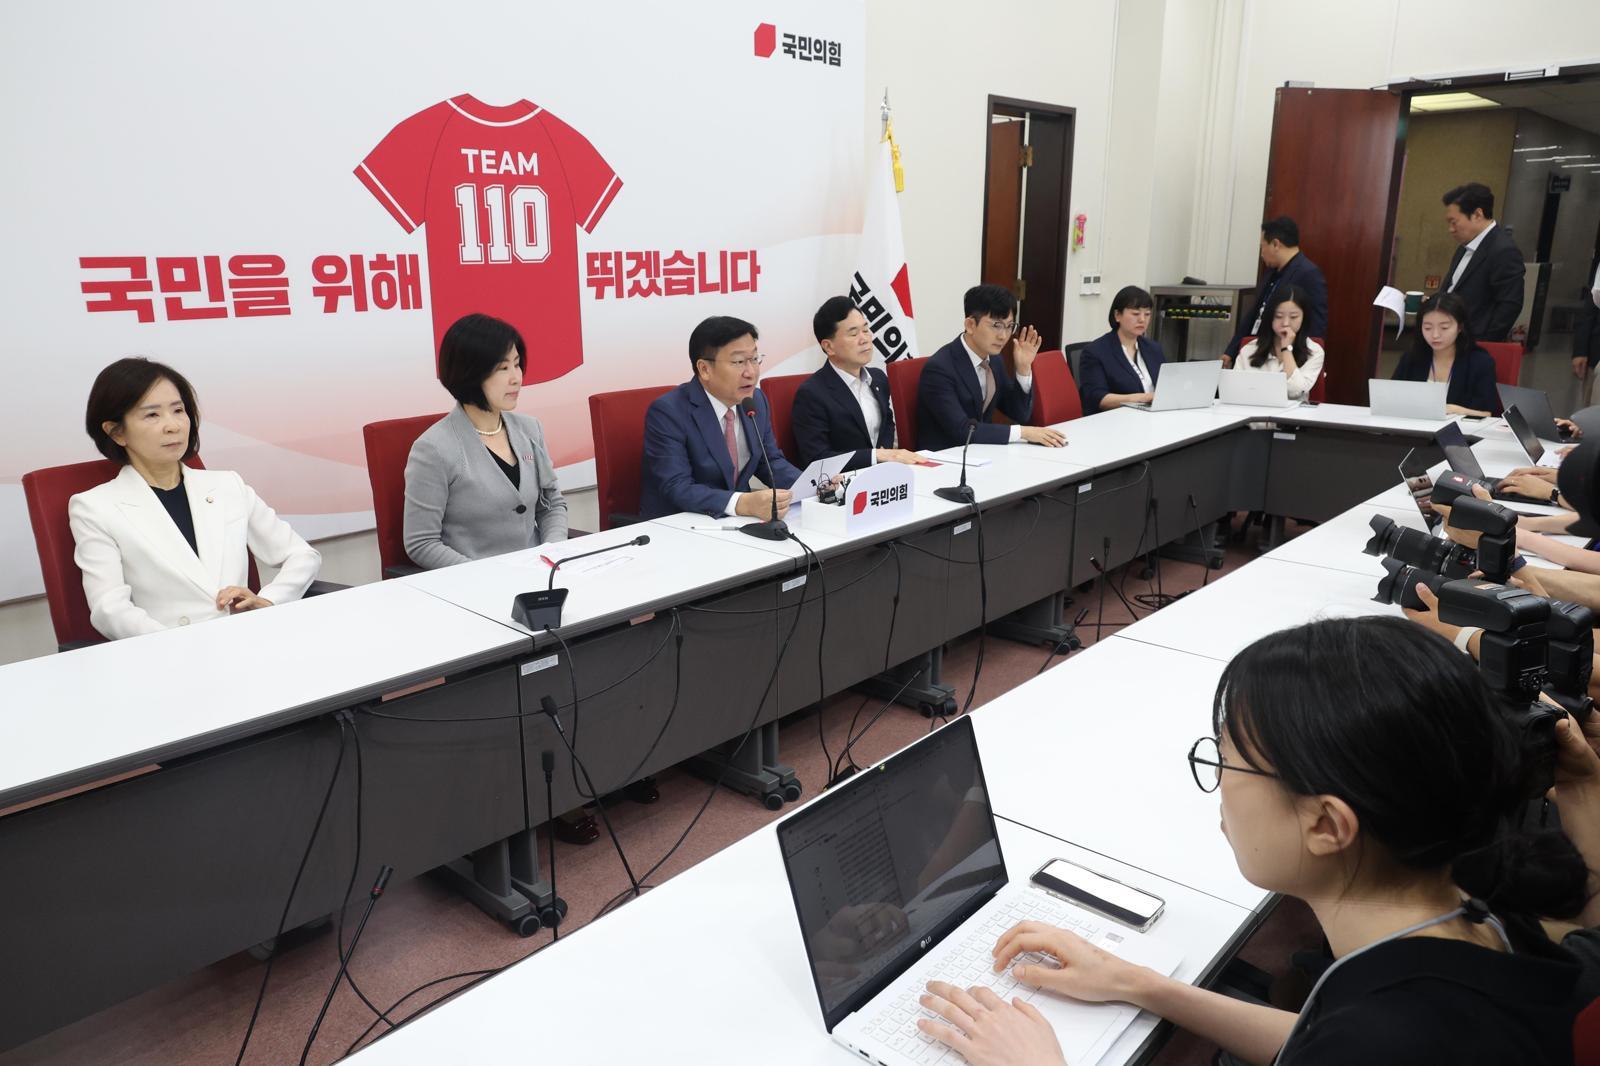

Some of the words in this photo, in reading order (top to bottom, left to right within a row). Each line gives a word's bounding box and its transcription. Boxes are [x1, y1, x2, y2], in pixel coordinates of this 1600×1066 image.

[782, 32, 841, 67] 국민의힘
[461, 148, 539, 176] TEAM
[455, 183, 551, 264] 110
[79, 254, 291, 323] 국민을
[311, 253, 423, 314] 위해
[586, 250, 761, 300] 뛰겠습니다
[870, 483, 908, 507] 국민의힘
